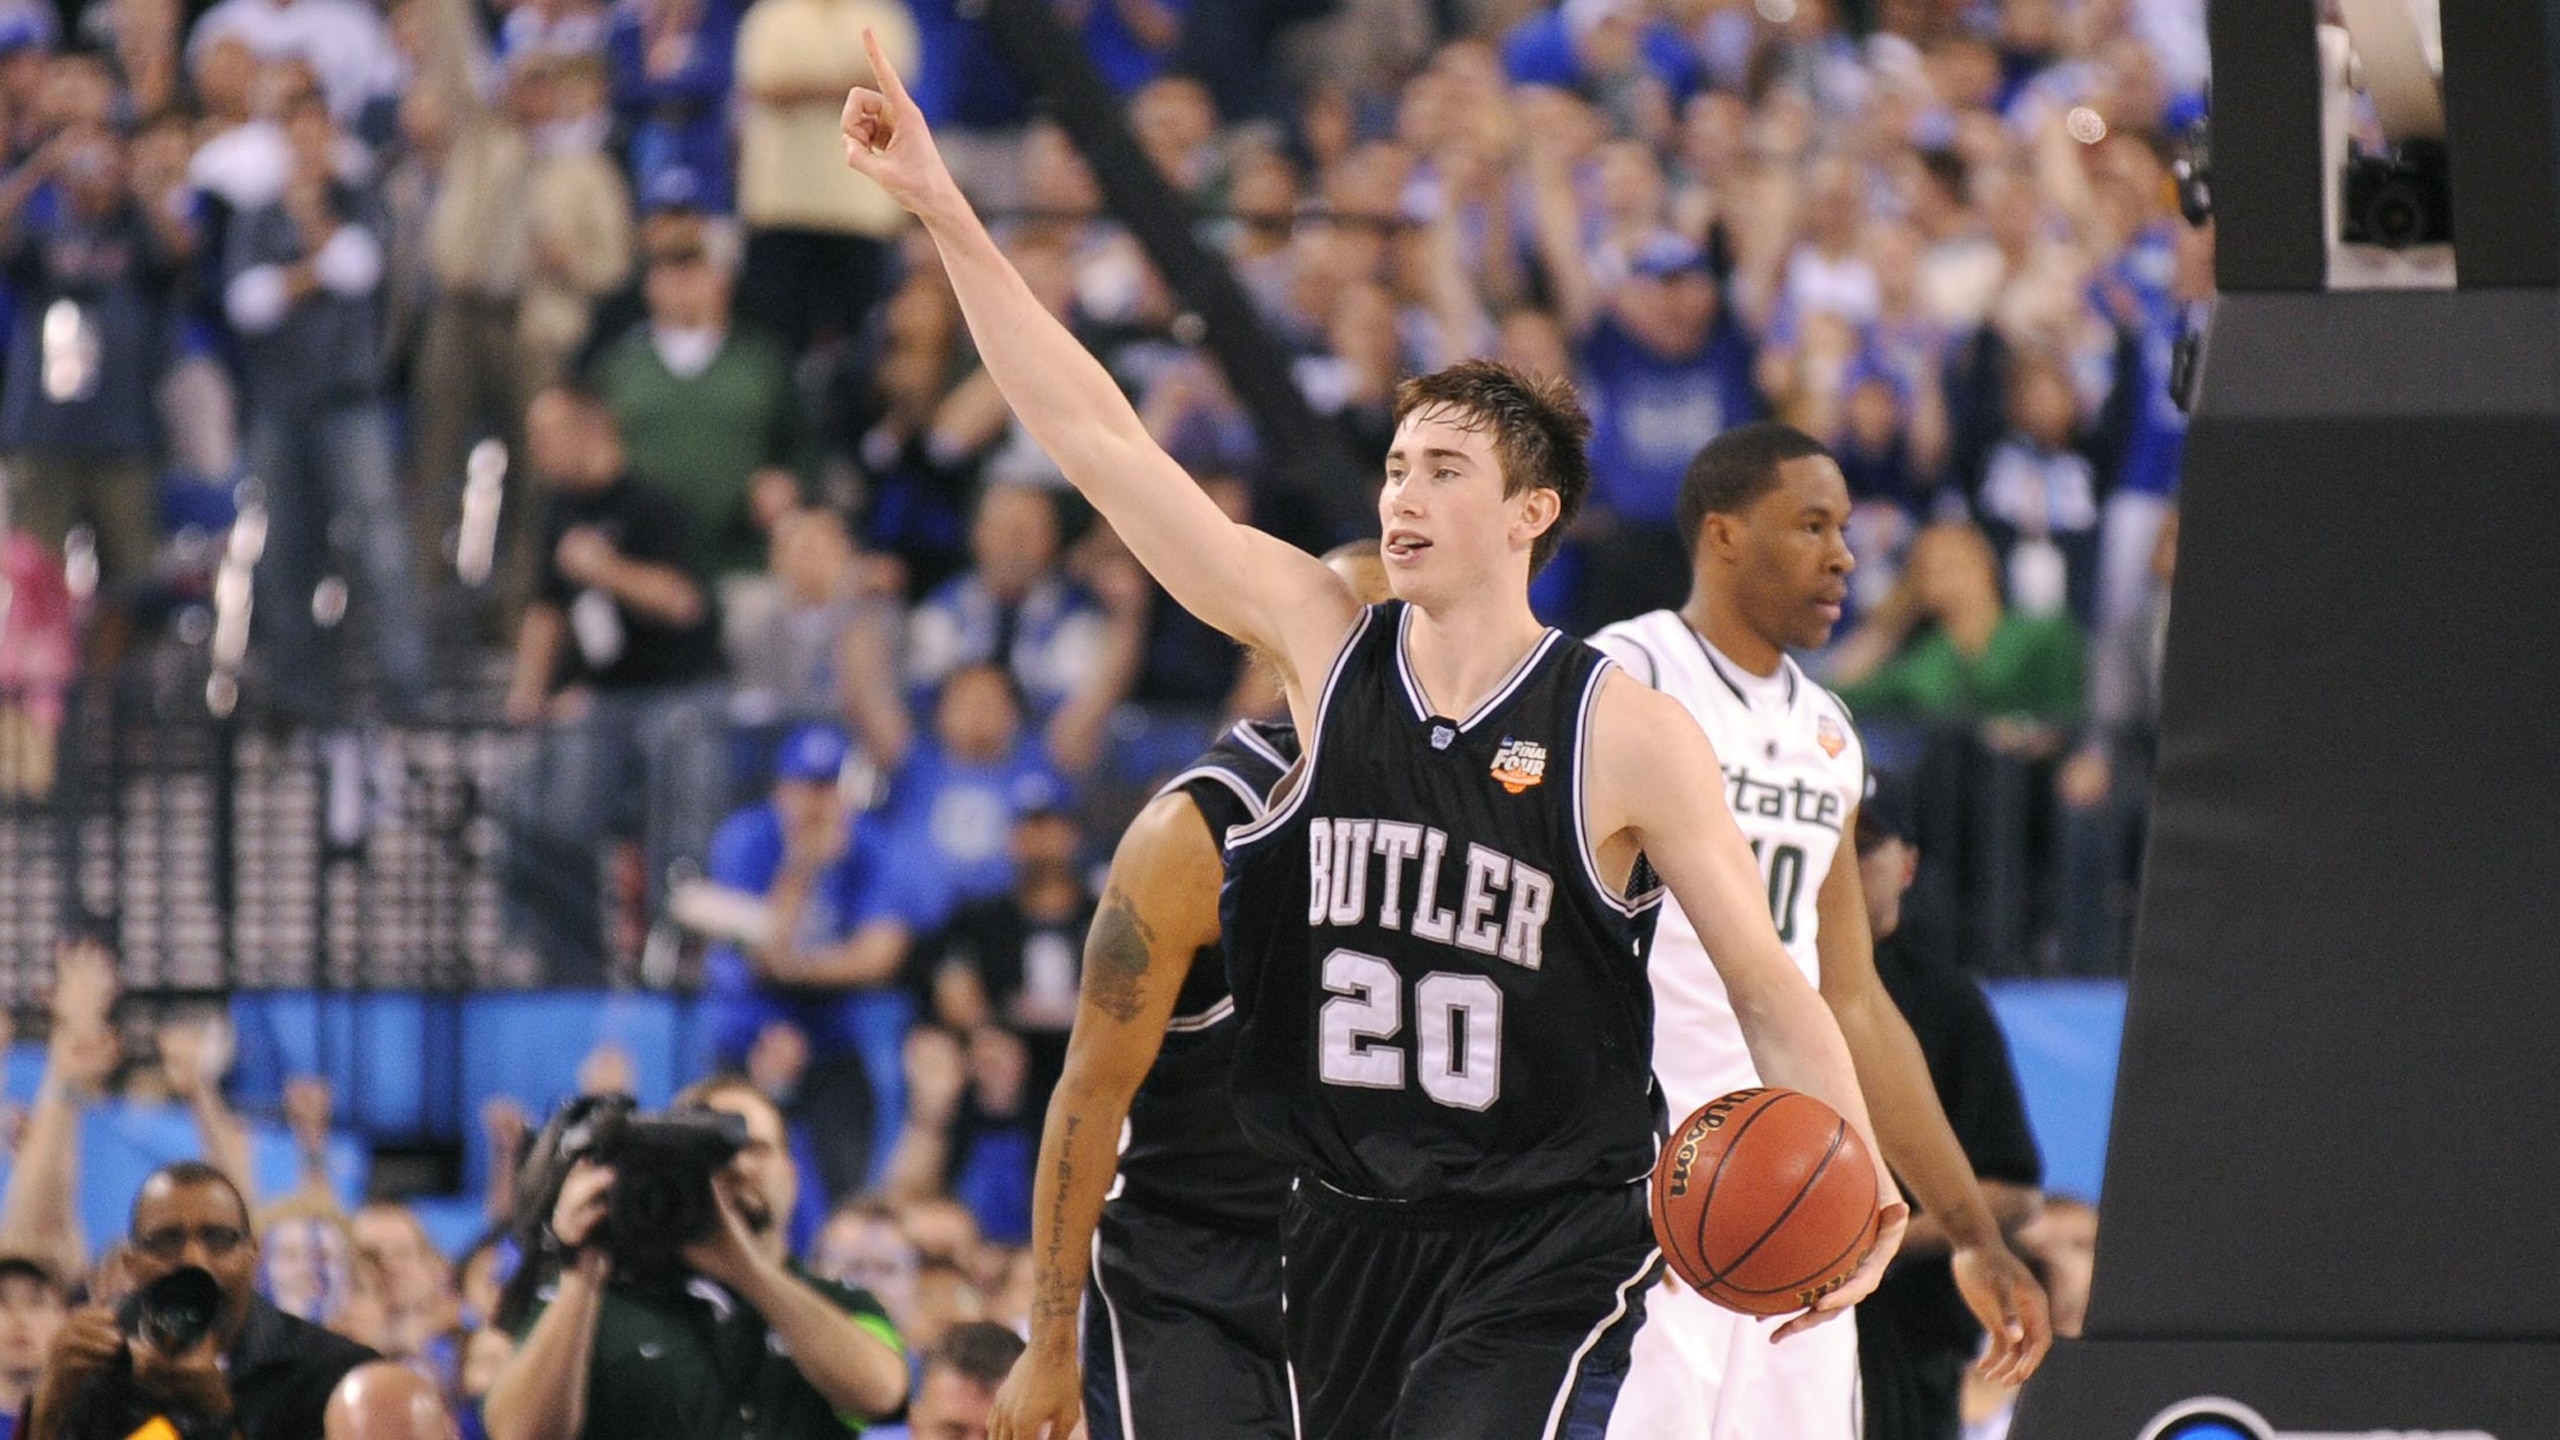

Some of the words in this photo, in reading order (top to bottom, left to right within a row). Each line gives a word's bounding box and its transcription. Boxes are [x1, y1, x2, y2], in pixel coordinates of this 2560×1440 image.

[1489, 748, 1546, 777] FOUR
[1511, 740, 1547, 760] FINAL
[1720, 764, 1842, 834] tate
[1308, 816, 1555, 971] BUTLER
[1750, 838, 1807, 944] 0
[1318, 947, 1504, 1113] 20
